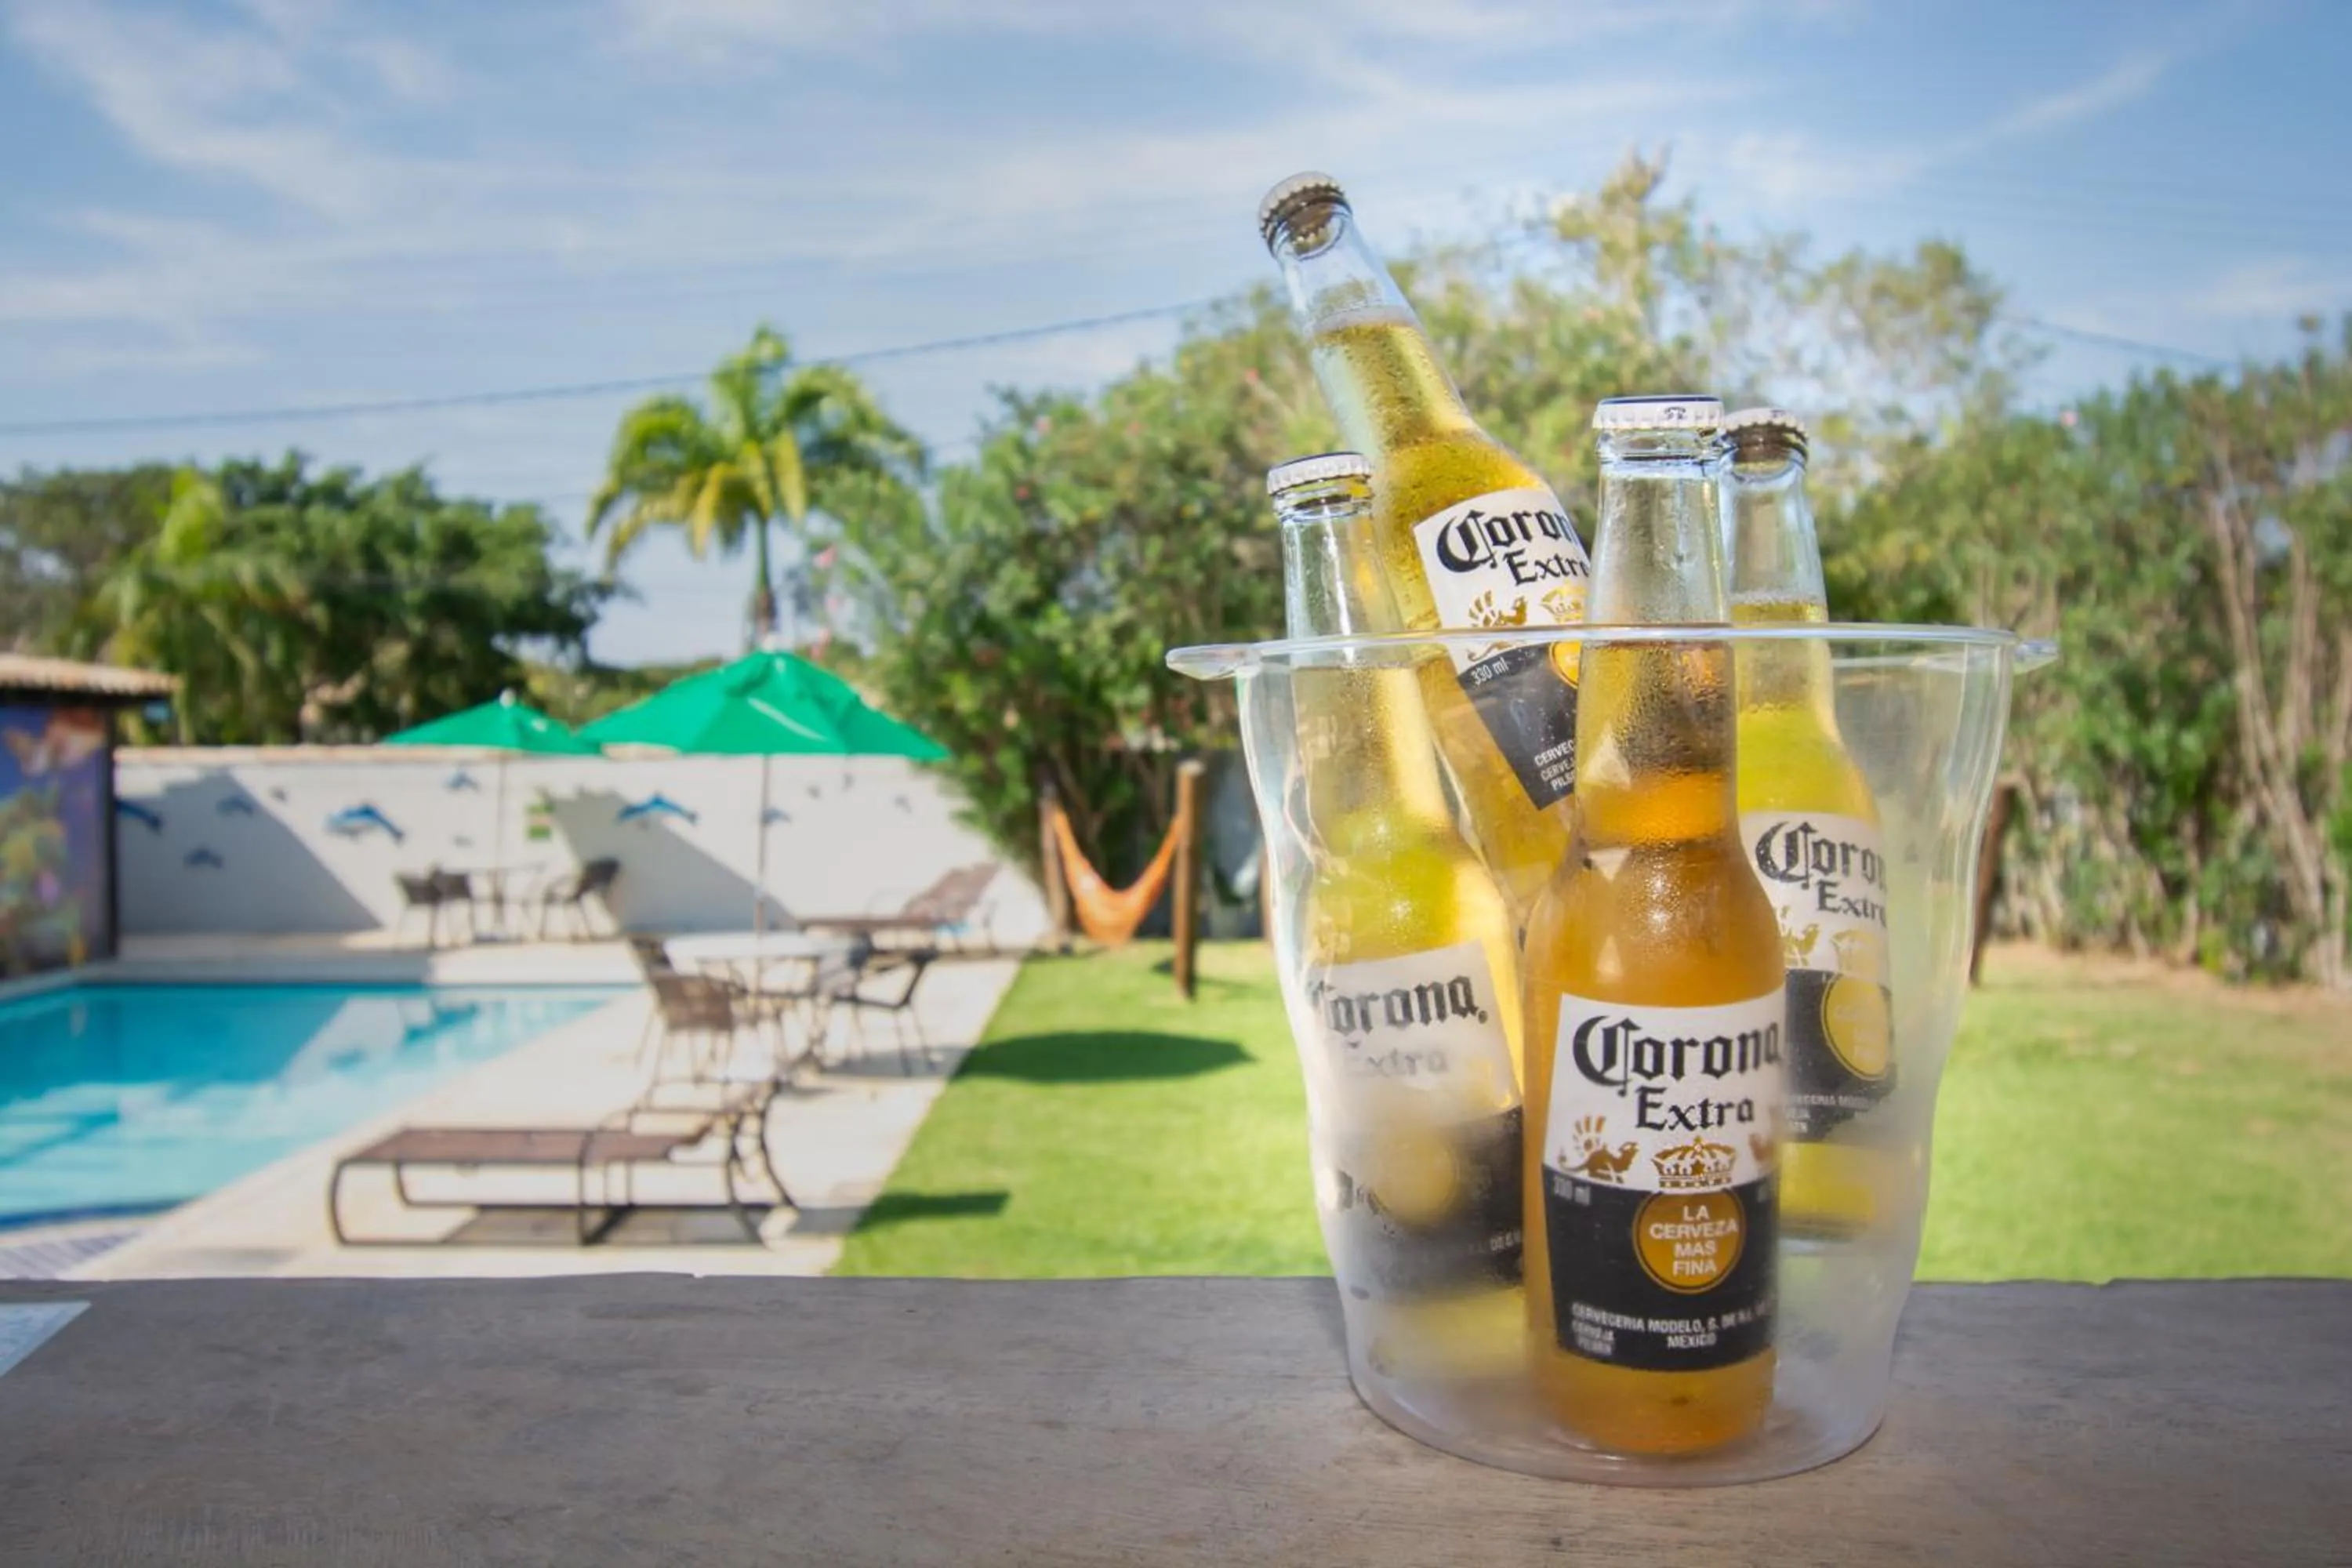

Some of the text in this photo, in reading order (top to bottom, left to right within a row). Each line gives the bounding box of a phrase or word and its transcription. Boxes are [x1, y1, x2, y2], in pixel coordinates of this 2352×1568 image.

[1436, 509, 1584, 573] Coron
[1471, 657, 1510, 685] 330 ml
[1635, 1085, 1755, 1131] Extra
[1682, 1204, 1710, 1222] LA
[1649, 1218, 1738, 1240] CERVEZA
[1674, 1240, 1717, 1258] MAS
[1672, 1258, 1717, 1277] FINA
